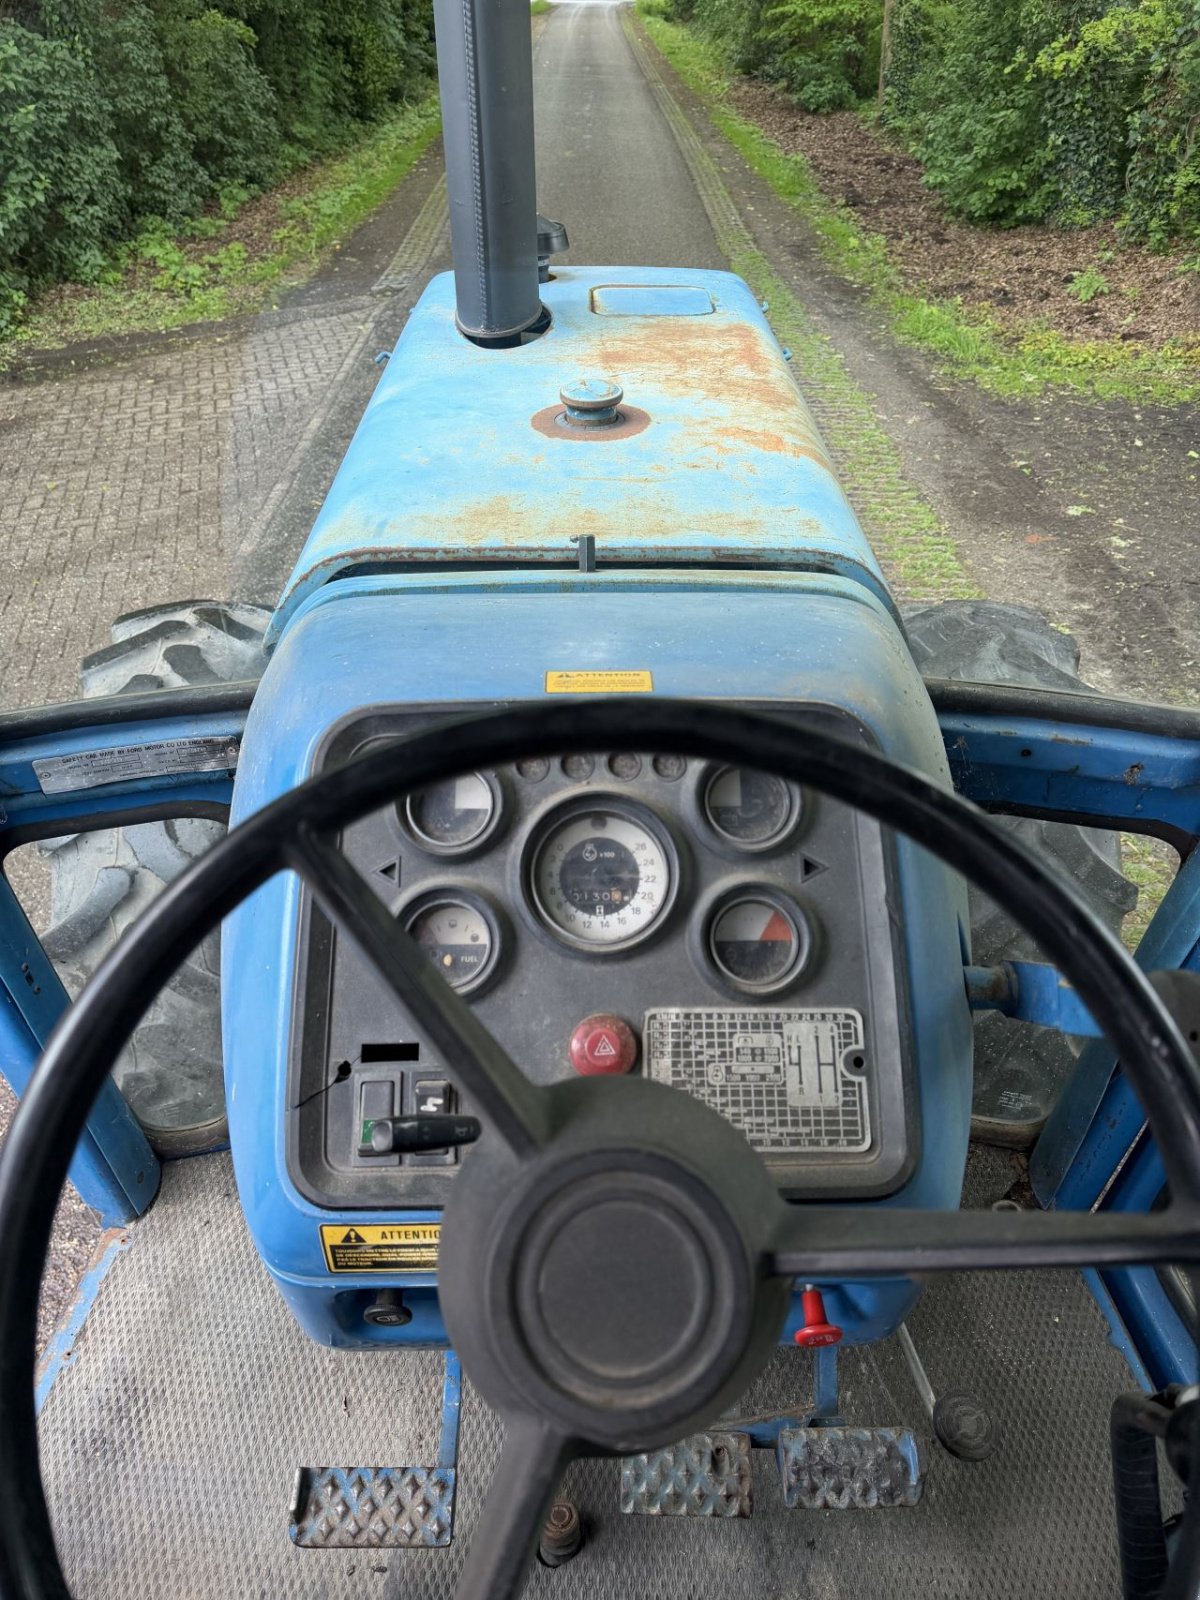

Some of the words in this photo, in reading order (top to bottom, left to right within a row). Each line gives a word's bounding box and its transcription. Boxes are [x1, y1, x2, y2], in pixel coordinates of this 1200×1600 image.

[144, 743, 165, 751] MOTOR
[641, 892, 654, 900] 20
[632, 907, 641, 915] 18
[380, 1230, 440, 1240] ATTENTIO
